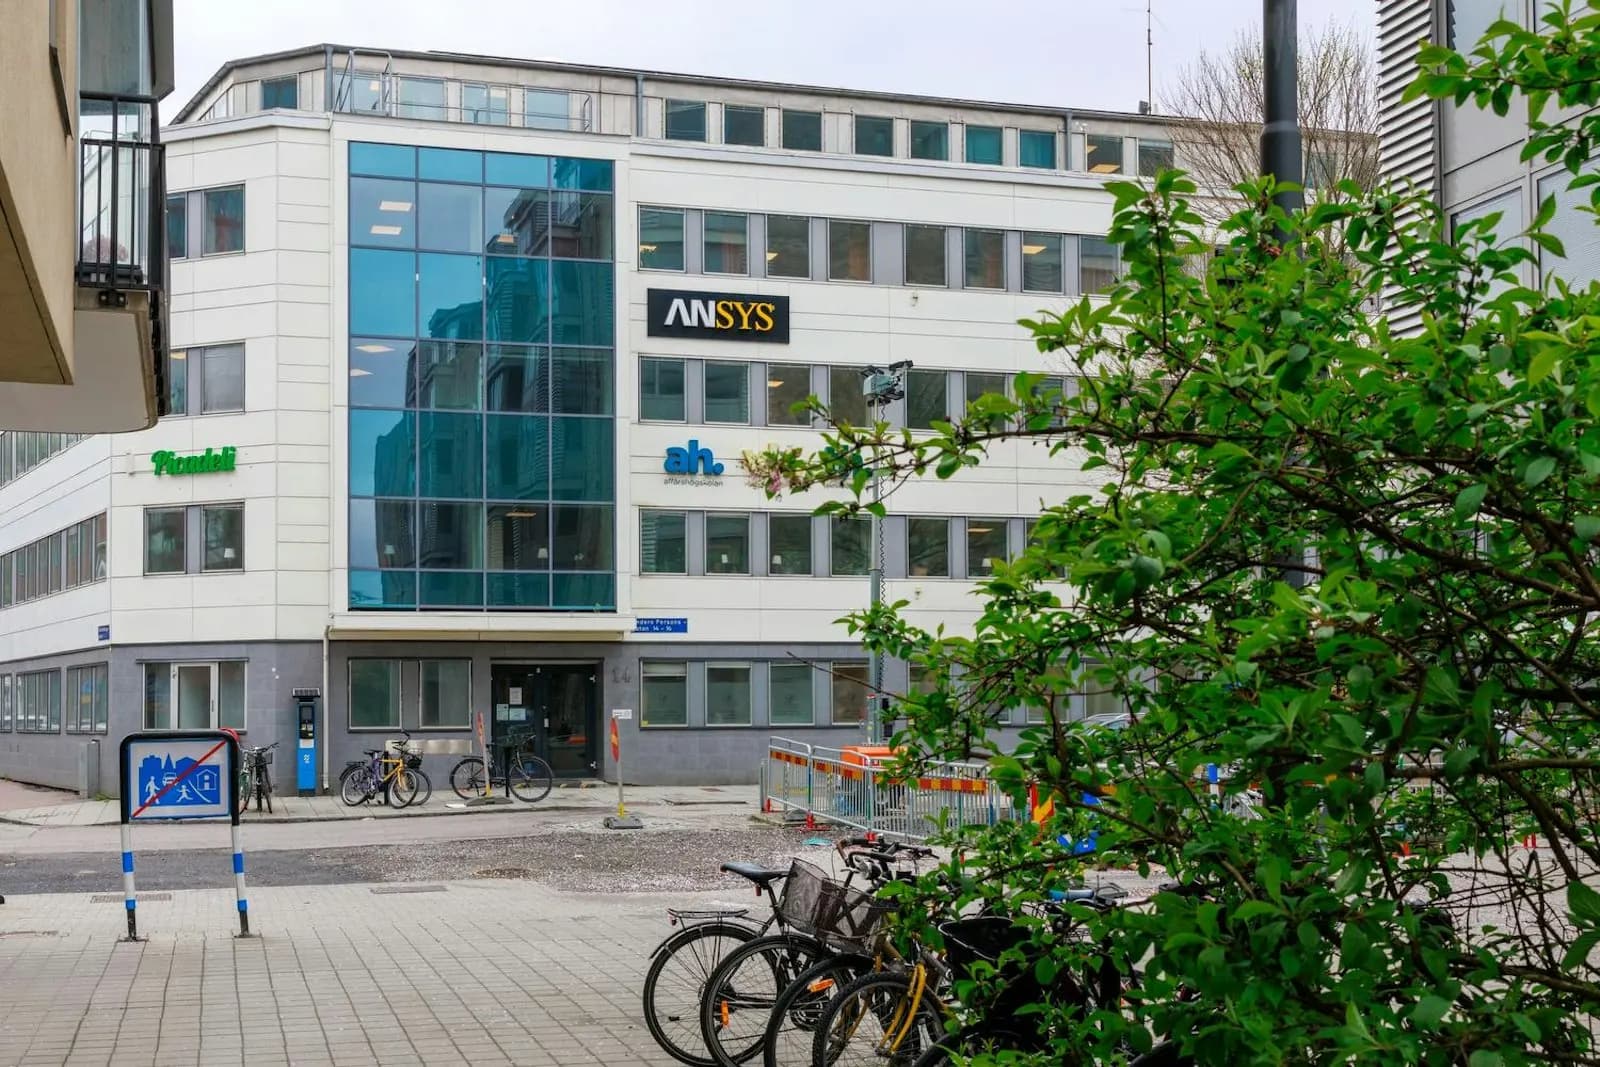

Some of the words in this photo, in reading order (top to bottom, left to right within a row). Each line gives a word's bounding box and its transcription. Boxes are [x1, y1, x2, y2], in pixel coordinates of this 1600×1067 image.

[663, 298, 775, 331] ANSYS
[151, 446, 236, 476] Picadeli
[664, 439, 724, 476] ah.
